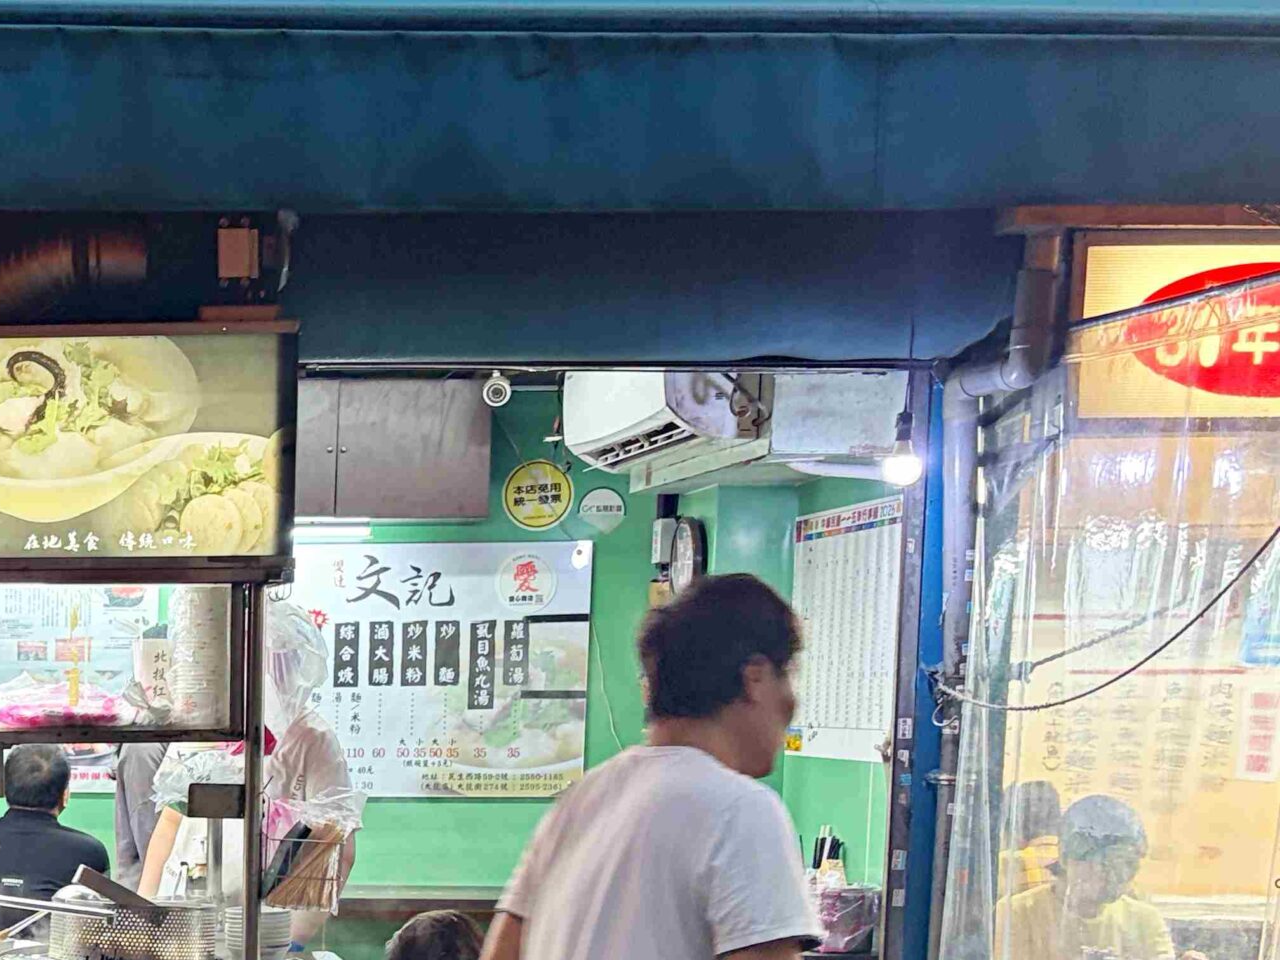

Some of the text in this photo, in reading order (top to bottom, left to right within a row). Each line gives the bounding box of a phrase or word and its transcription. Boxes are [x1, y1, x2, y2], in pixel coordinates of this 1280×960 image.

[513, 483, 562, 494] 本店免用
[514, 495, 562, 507] 統一發票
[23, 530, 197, 552] 在地美食 傳統口味
[346, 554, 455, 610] 文記
[372, 624, 390, 683] 滷大腸
[405, 623, 423, 683] 炒米粉
[372, 747, 386, 758] 60
[396, 747, 410, 758] 50
[413, 747, 427, 758] 35
[429, 747, 443, 758] 50
[446, 747, 459, 758] 35
[473, 747, 487, 758] 35
[507, 747, 521, 758] 35
